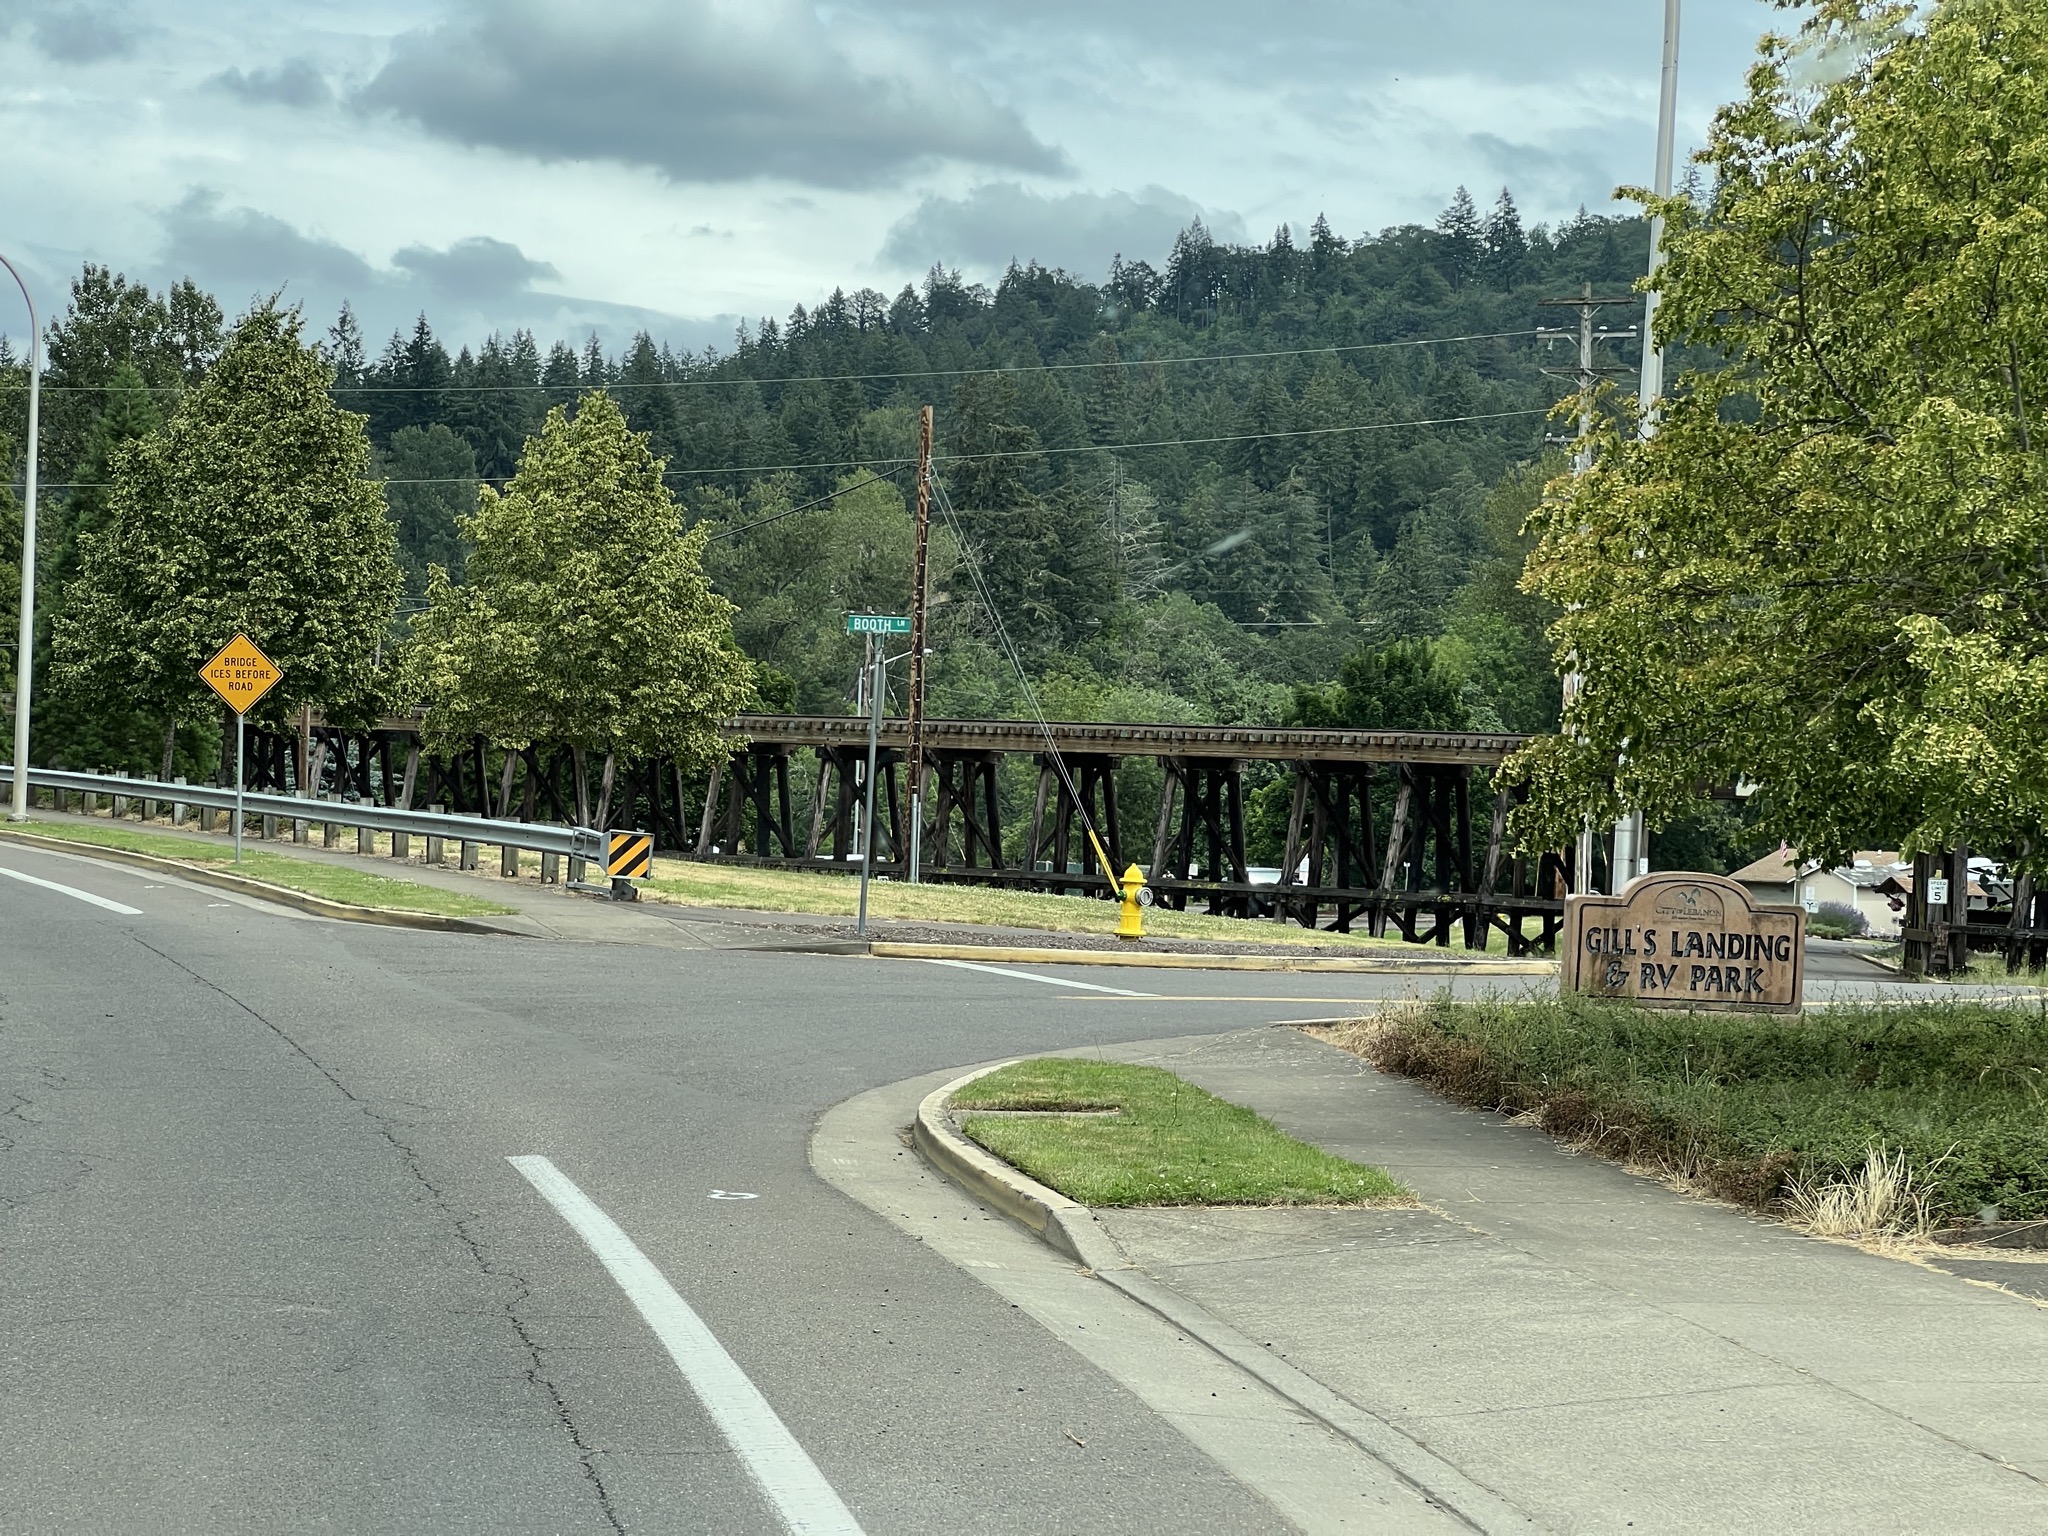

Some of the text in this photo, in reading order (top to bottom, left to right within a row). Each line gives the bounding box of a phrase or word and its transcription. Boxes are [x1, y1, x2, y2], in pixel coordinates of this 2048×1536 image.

[854, 618, 891, 631] BOOTH
[224, 657, 257, 666] BRIDGE
[210, 669, 271, 679] ICES BEFORE
[228, 682, 253, 691] ROAD
[1934, 892, 1942, 900] 5
[1683, 907, 1721, 916] LEBANON
[1586, 926, 1790, 962] GILL'S LANDING
[1606, 961, 1764, 993] & RV PARK
